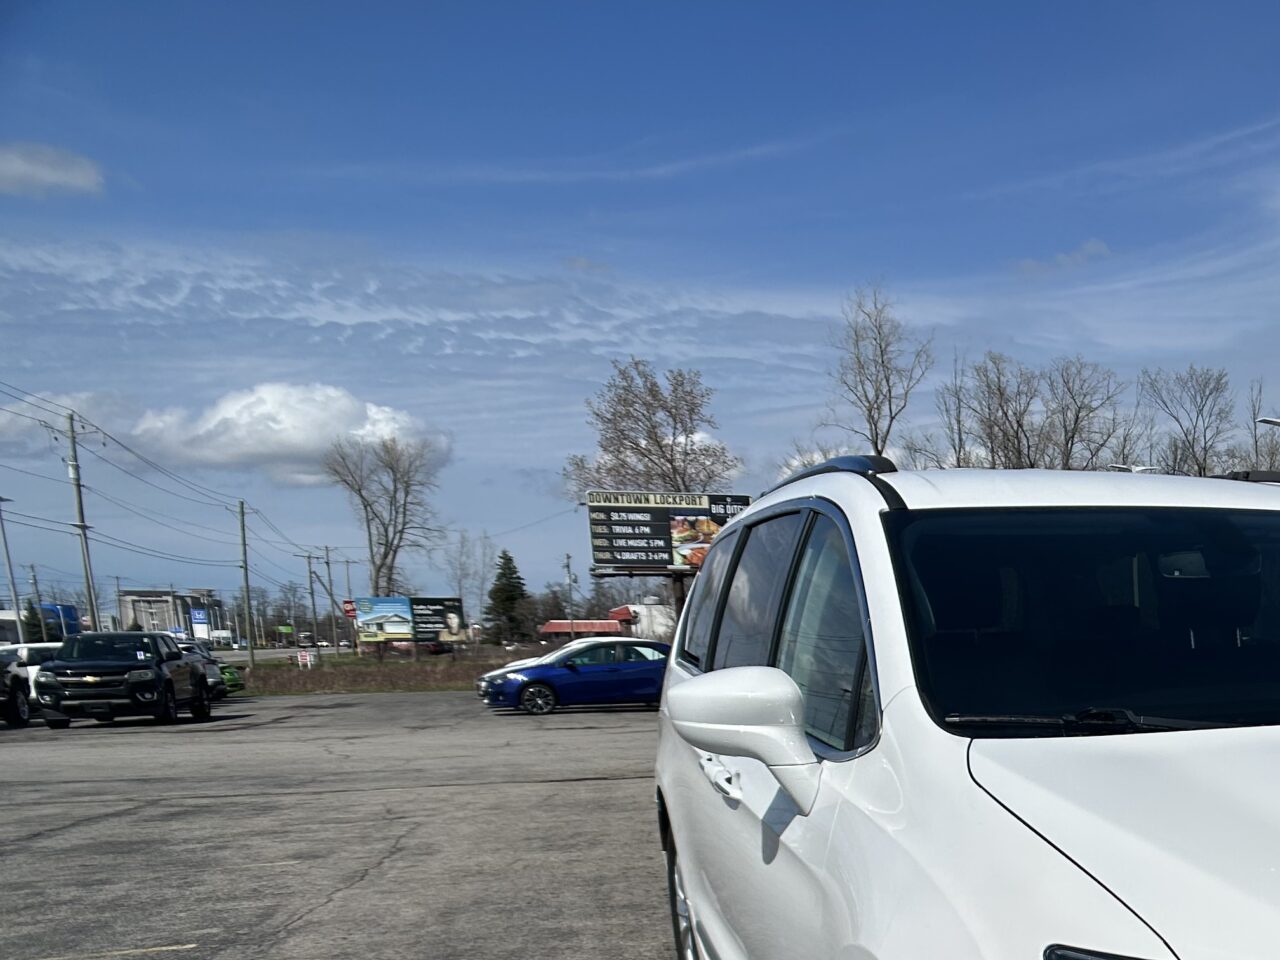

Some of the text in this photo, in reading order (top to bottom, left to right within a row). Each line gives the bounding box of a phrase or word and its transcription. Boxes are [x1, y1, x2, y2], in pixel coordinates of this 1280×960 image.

[588, 493, 703, 506] DOWNTOWN LOCKPORT
[711, 504, 725, 514] BIG
[640, 525, 650, 533] PM
[612, 539, 627, 547] LIVE
[627, 539, 648, 547] MUSIC
[654, 539, 665, 547] PM
[621, 552, 646, 560] DRAFTS
[658, 552, 669, 560] PM
